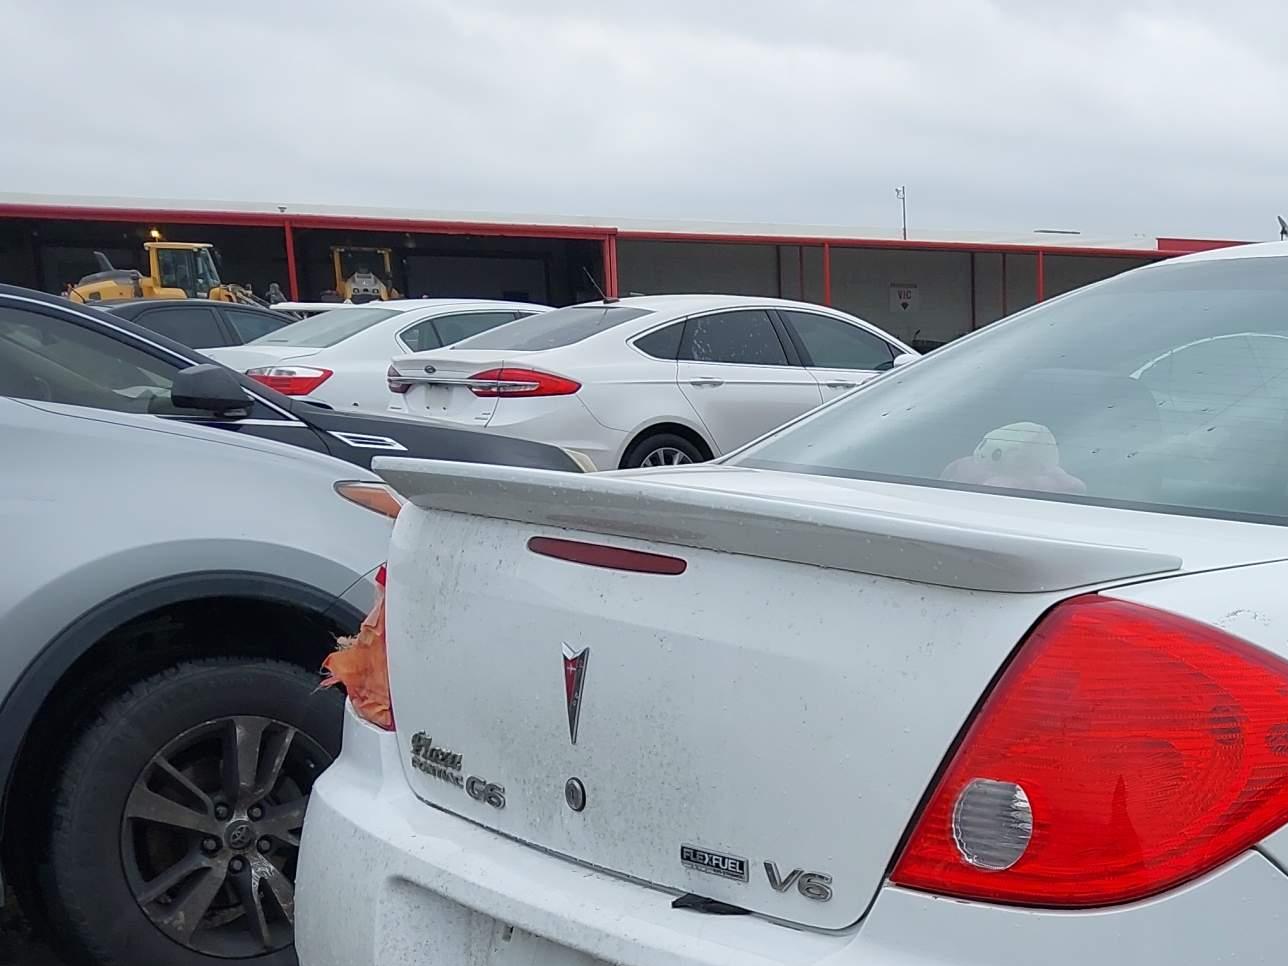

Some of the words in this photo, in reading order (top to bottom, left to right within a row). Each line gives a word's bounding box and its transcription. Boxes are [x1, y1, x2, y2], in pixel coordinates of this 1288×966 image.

[465, 775, 506, 809] G6
[682, 847, 745, 874] FLEXFUEL
[763, 859, 834, 903] V6
